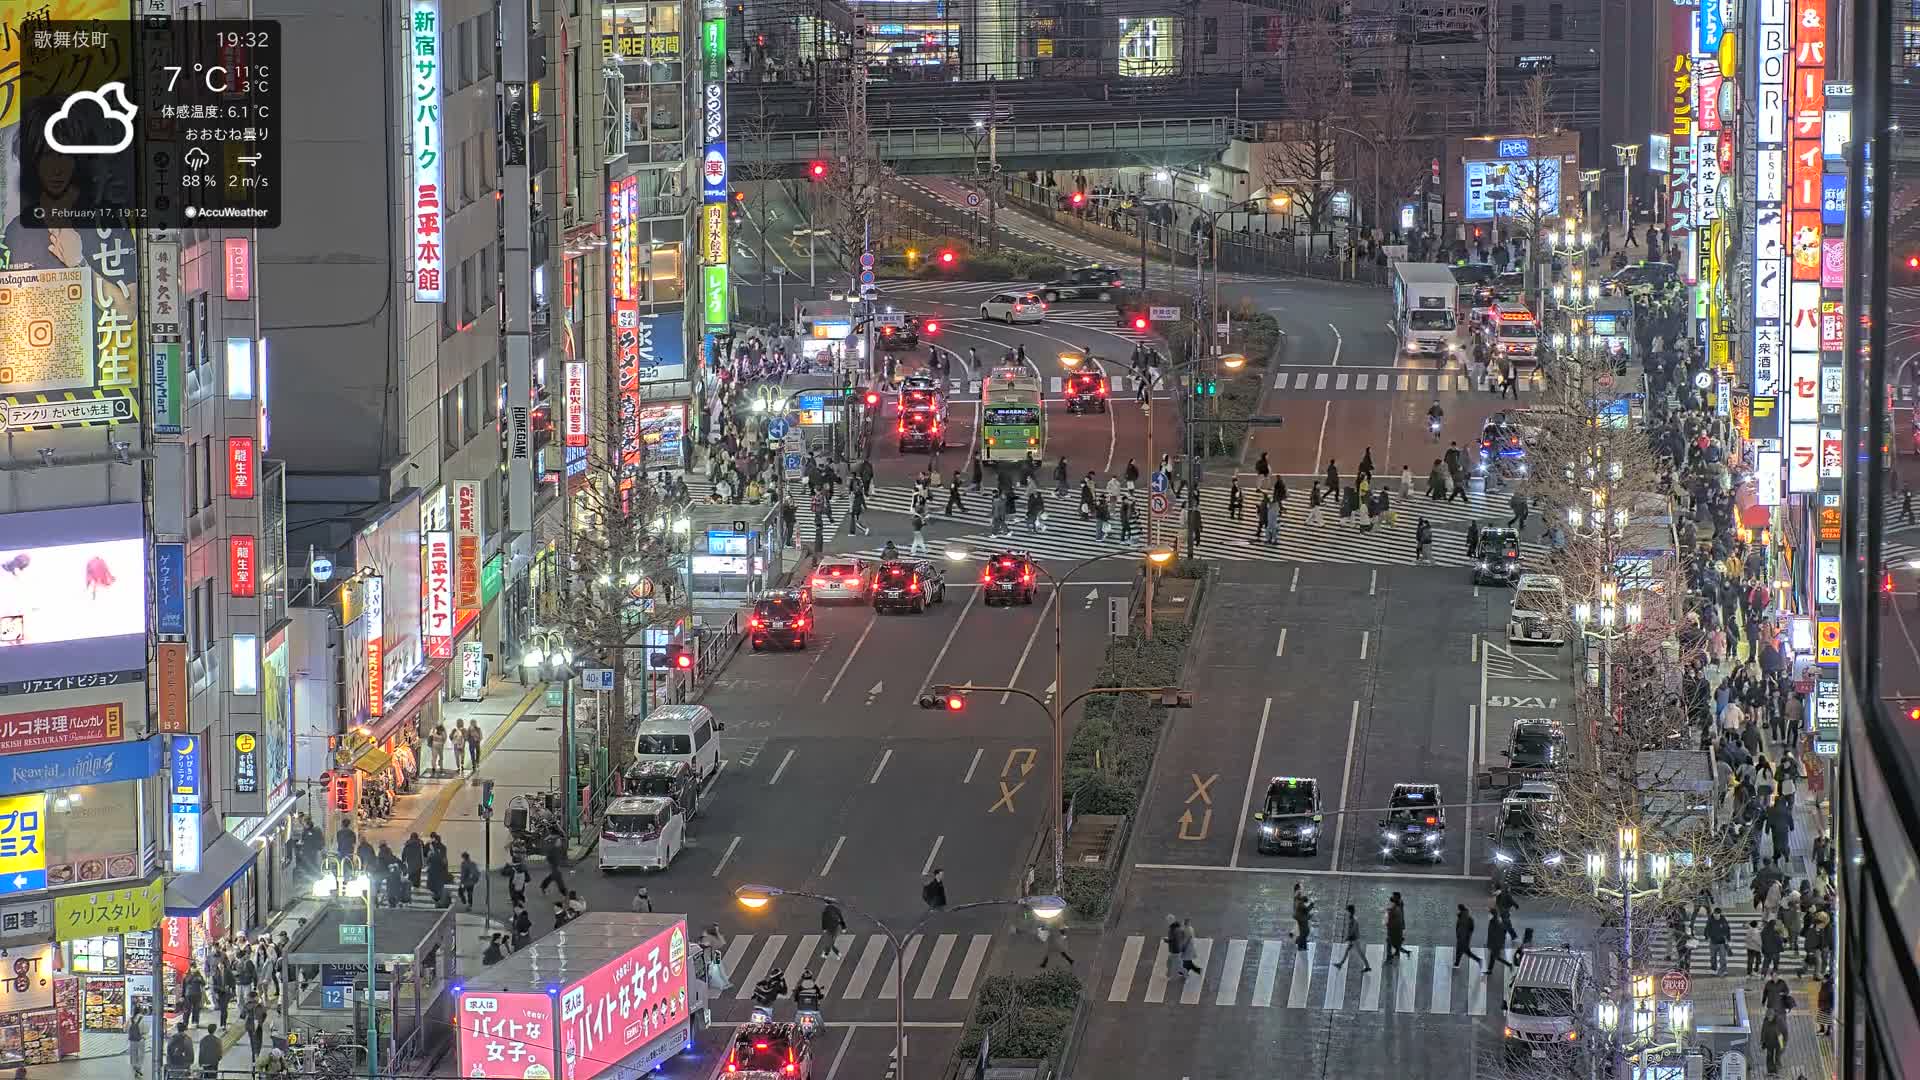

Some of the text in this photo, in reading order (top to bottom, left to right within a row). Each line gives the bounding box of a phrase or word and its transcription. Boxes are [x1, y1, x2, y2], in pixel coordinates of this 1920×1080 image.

[618, 38, 645, 55] 祝日
[652, 36, 679, 54] 夜間
[414, 11, 437, 169] 新宿サンパーク
[707, 85, 721, 137] もつなべ
[1704, 86, 1716, 120] アコム
[705, 160, 724, 177] 薬
[1671, 146, 1692, 232] エスパス
[417, 184, 440, 291] 三平本館
[0, 273, 40, 289] nstagram
[708, 275, 722, 313] レイク
[156, 324, 174, 333] 3F
[1758, 330, 1771, 381] 大衆酒場
[155, 352, 168, 415] FamilyMart
[1794, 308, 1817, 468] パセラ
[12, 404, 111, 422] テンクリ たいせい先生
[512, 406, 528, 460] HOMEGAME
[234, 450, 247, 487] 龍生堂
[459, 486, 471, 531] GAME
[1827, 496, 1838, 505] 3F
[236, 547, 249, 582] 龍生堂
[159, 554, 170, 605] ゲウチャイ
[432, 542, 449, 630] 三平ストア
[1826, 575, 1838, 601] ねぎし
[23, 673, 119, 694] リアエイドビジョン
[0, 715, 68, 738] ルコ料理
[108, 710, 118, 736] 5F
[24, 734, 67, 747] RESTAURANT
[178, 805, 193, 813] 2F
[0, 809, 38, 835] プロ
[0, 834, 39, 857] ミス
[3, 911, 38, 932] 囲碁
[68, 902, 141, 927] クリスタル
[326, 990, 341, 1003] 12
[1664, 979, 1686, 990] 消火栓
[469, 1000, 494, 1009] 求人は
[472, 1016, 542, 1039] バイトな
[486, 1040, 536, 1063] 女子。
